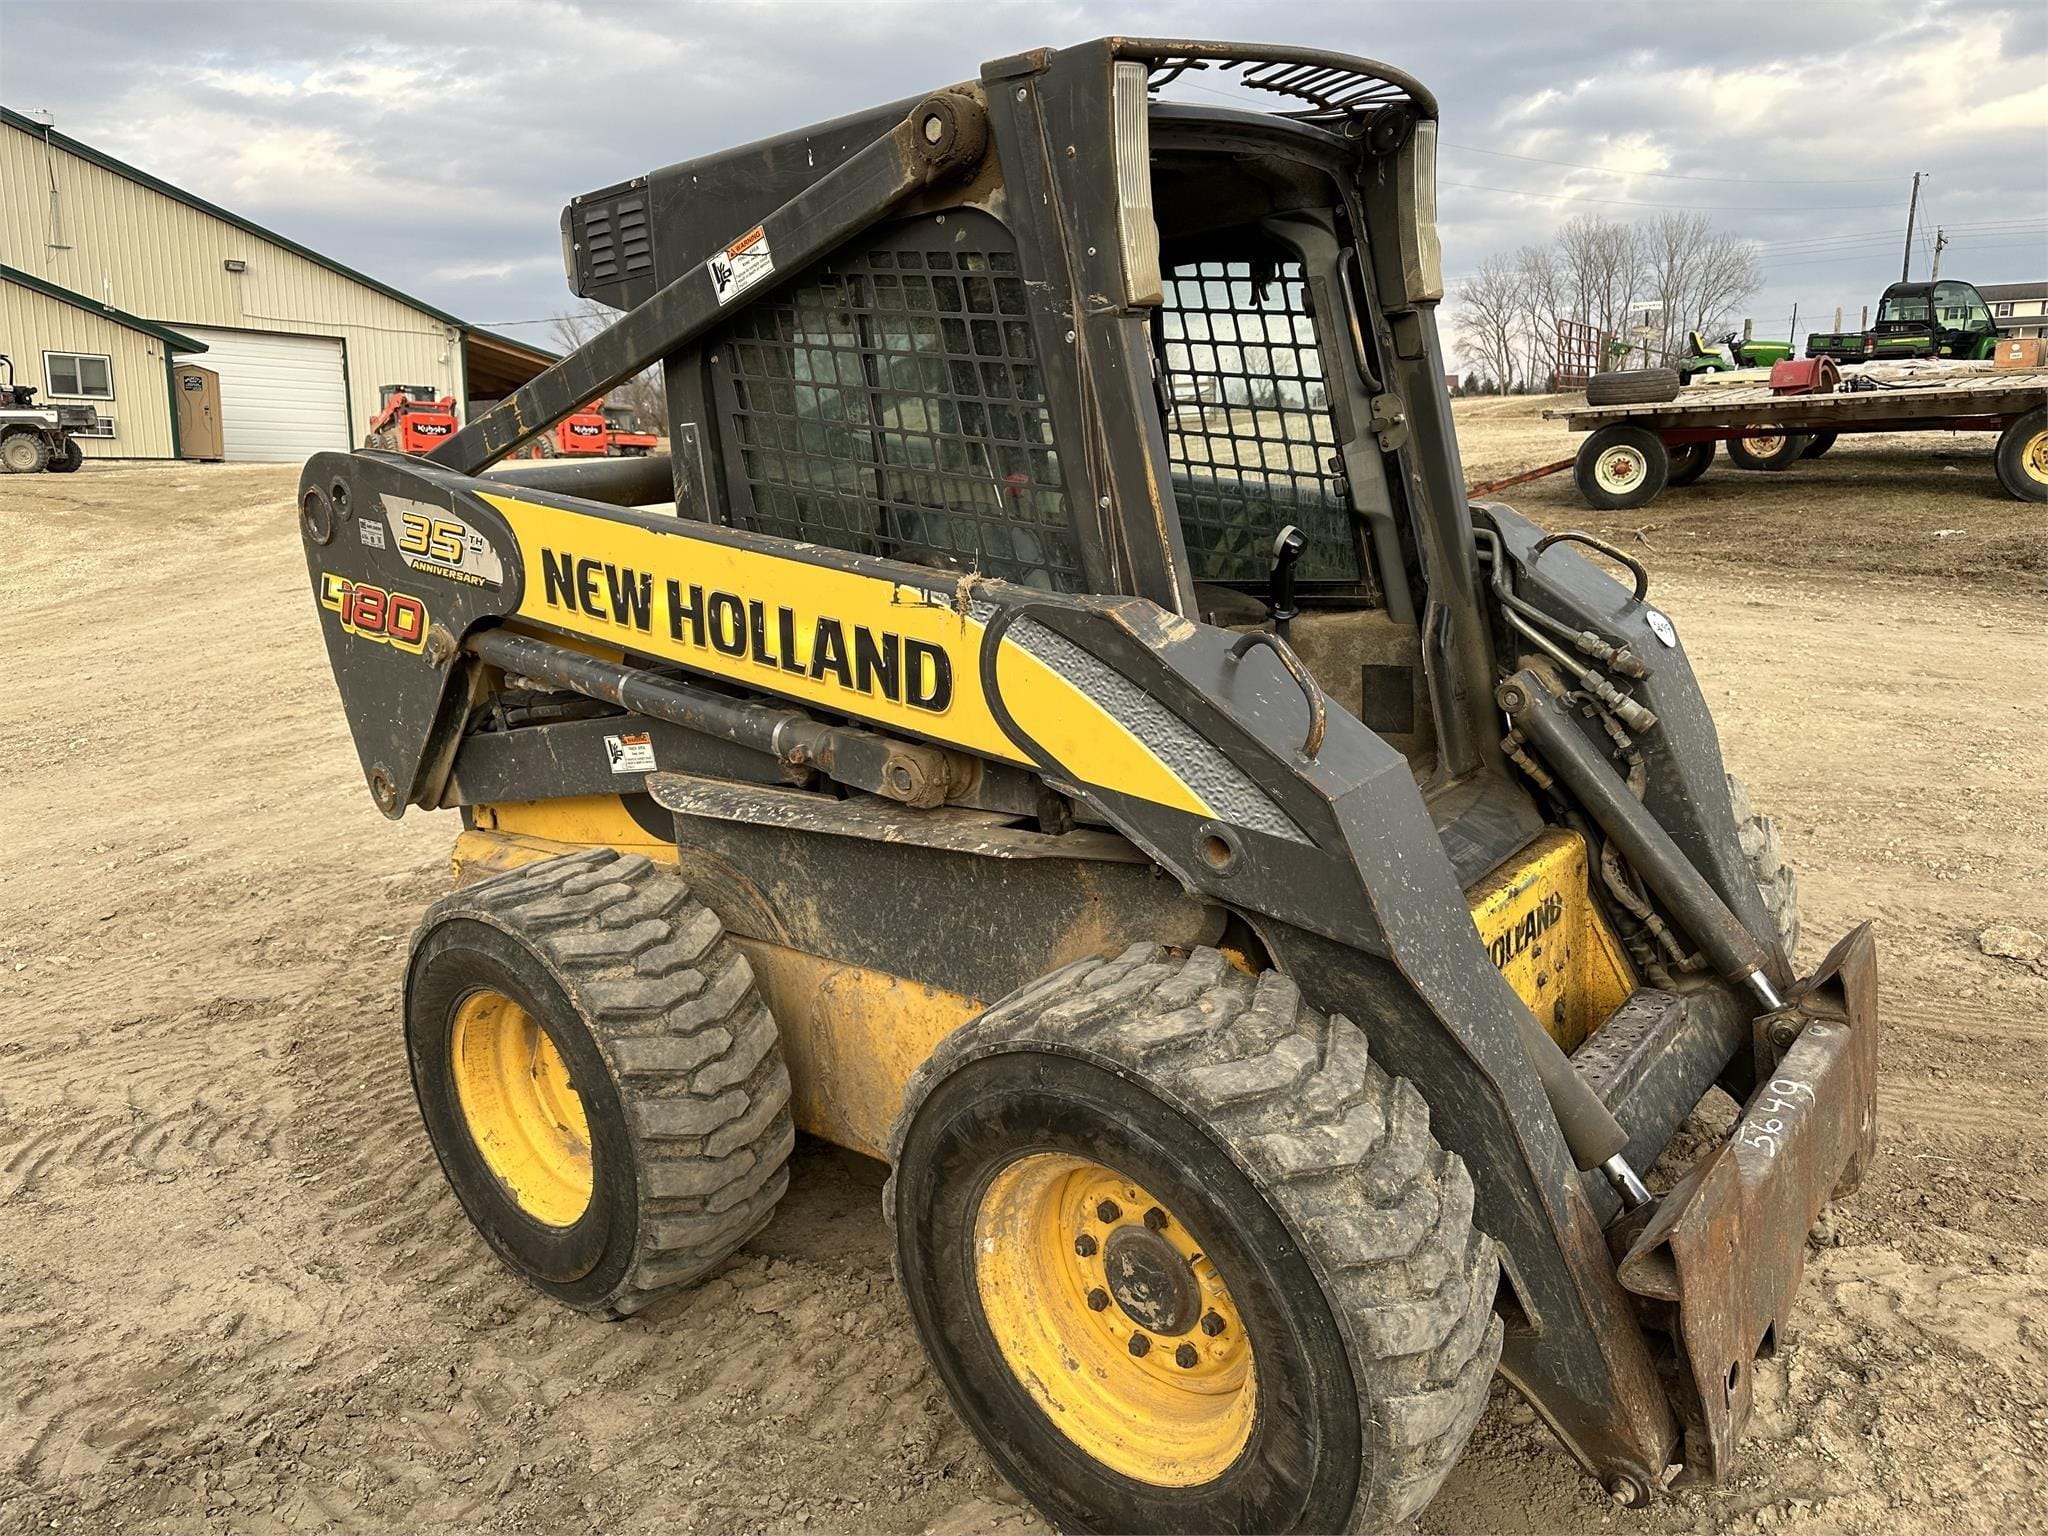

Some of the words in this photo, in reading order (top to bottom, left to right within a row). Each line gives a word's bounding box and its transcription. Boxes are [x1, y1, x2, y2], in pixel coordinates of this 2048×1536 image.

[735, 230, 761, 251] WARNING
[417, 424, 447, 434] Kubota
[399, 512, 466, 566] 35
[469, 535, 484, 547] TH
[412, 560, 486, 587] ANNIVERSARY
[321, 574, 427, 647] L180
[541, 547, 653, 633] NEW
[666, 578, 954, 714] HOLLAND
[1739, 1079, 1816, 1159] 5649
